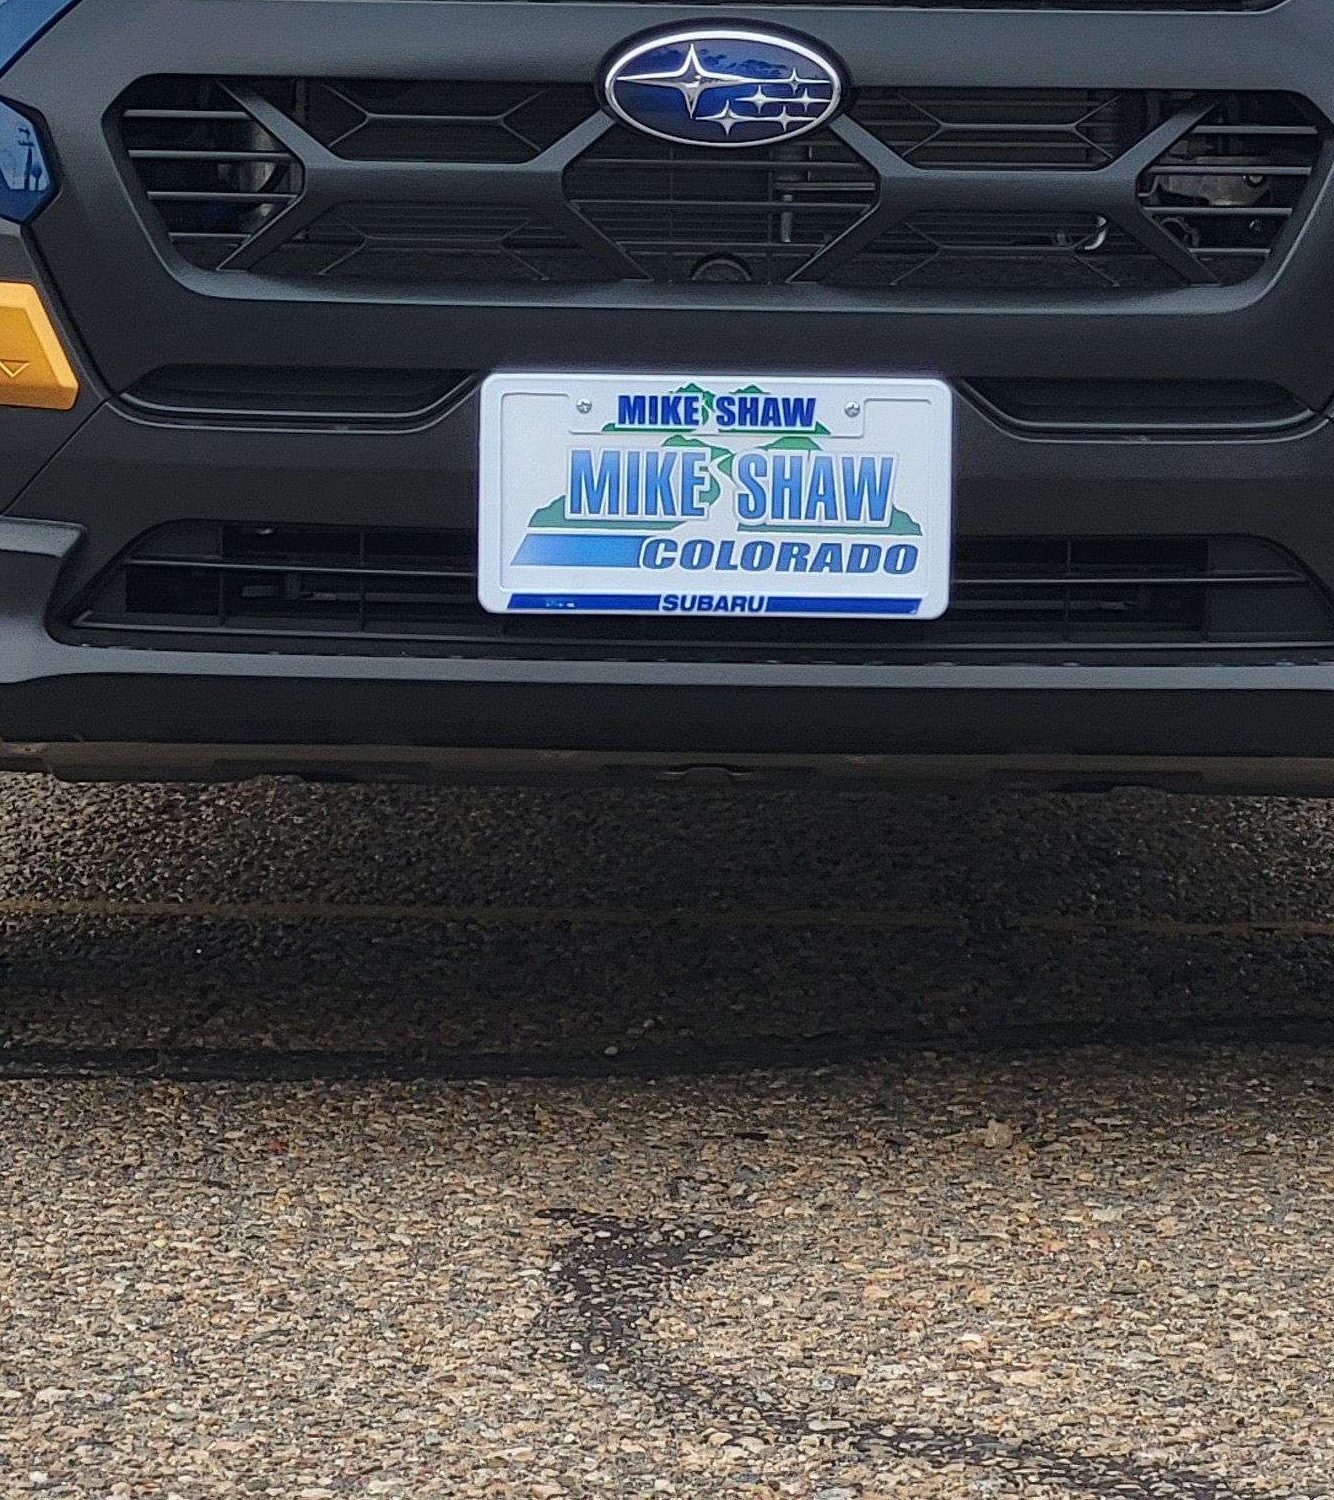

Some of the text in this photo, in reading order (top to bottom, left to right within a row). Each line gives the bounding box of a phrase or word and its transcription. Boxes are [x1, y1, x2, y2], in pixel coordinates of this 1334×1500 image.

[617, 394, 817, 427] MIKE SHAW
[569, 449, 894, 522] MIKE SHAW
[641, 537, 919, 575] COLORADO
[660, 593, 765, 614] SUBARU
